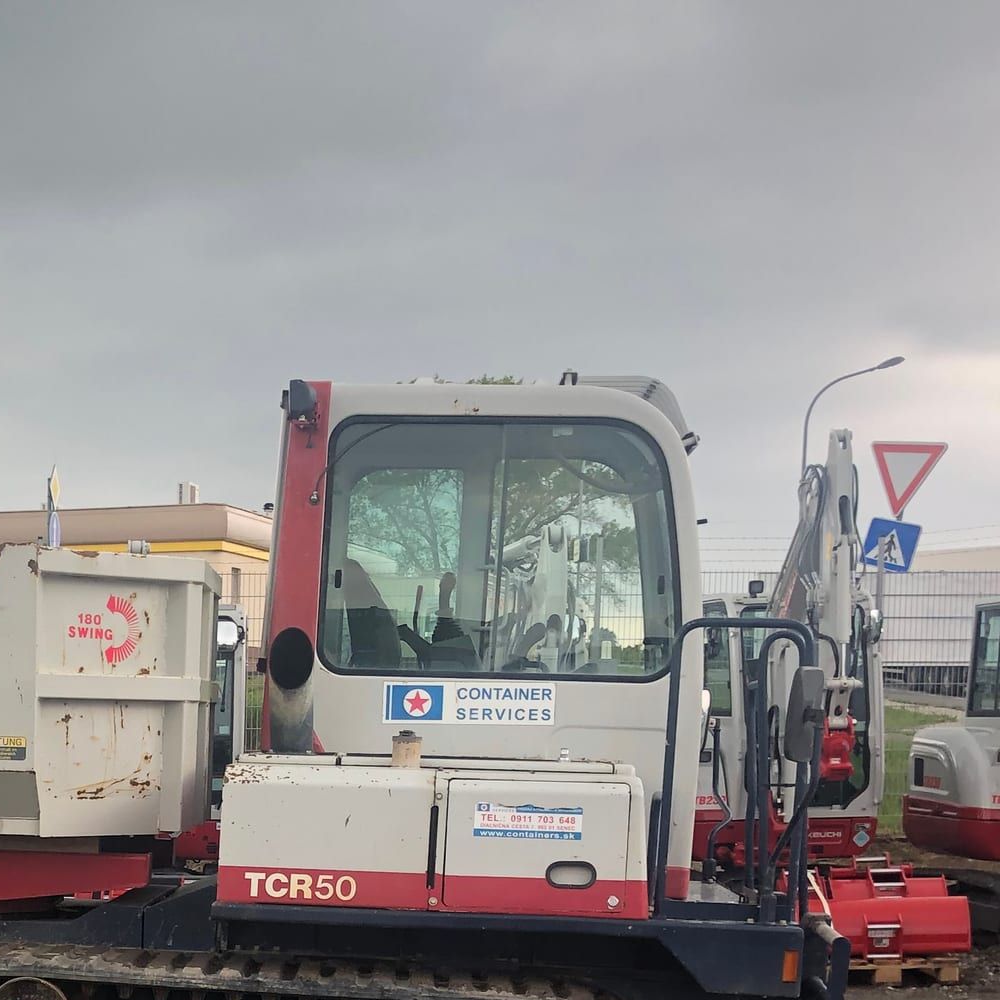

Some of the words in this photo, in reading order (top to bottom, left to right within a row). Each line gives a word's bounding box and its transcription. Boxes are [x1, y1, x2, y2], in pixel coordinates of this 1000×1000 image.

[78, 613, 102, 625] 180
[68, 626, 113, 640] SWING
[457, 687, 552, 701] CONTAINER
[456, 708, 551, 721] SERVICES
[510, 815, 532, 823] 0911
[538, 815, 554, 824] 703
[559, 817, 576, 825] 648
[480, 830, 576, 840] www.containers.sk
[244, 872, 357, 901] TCR50
